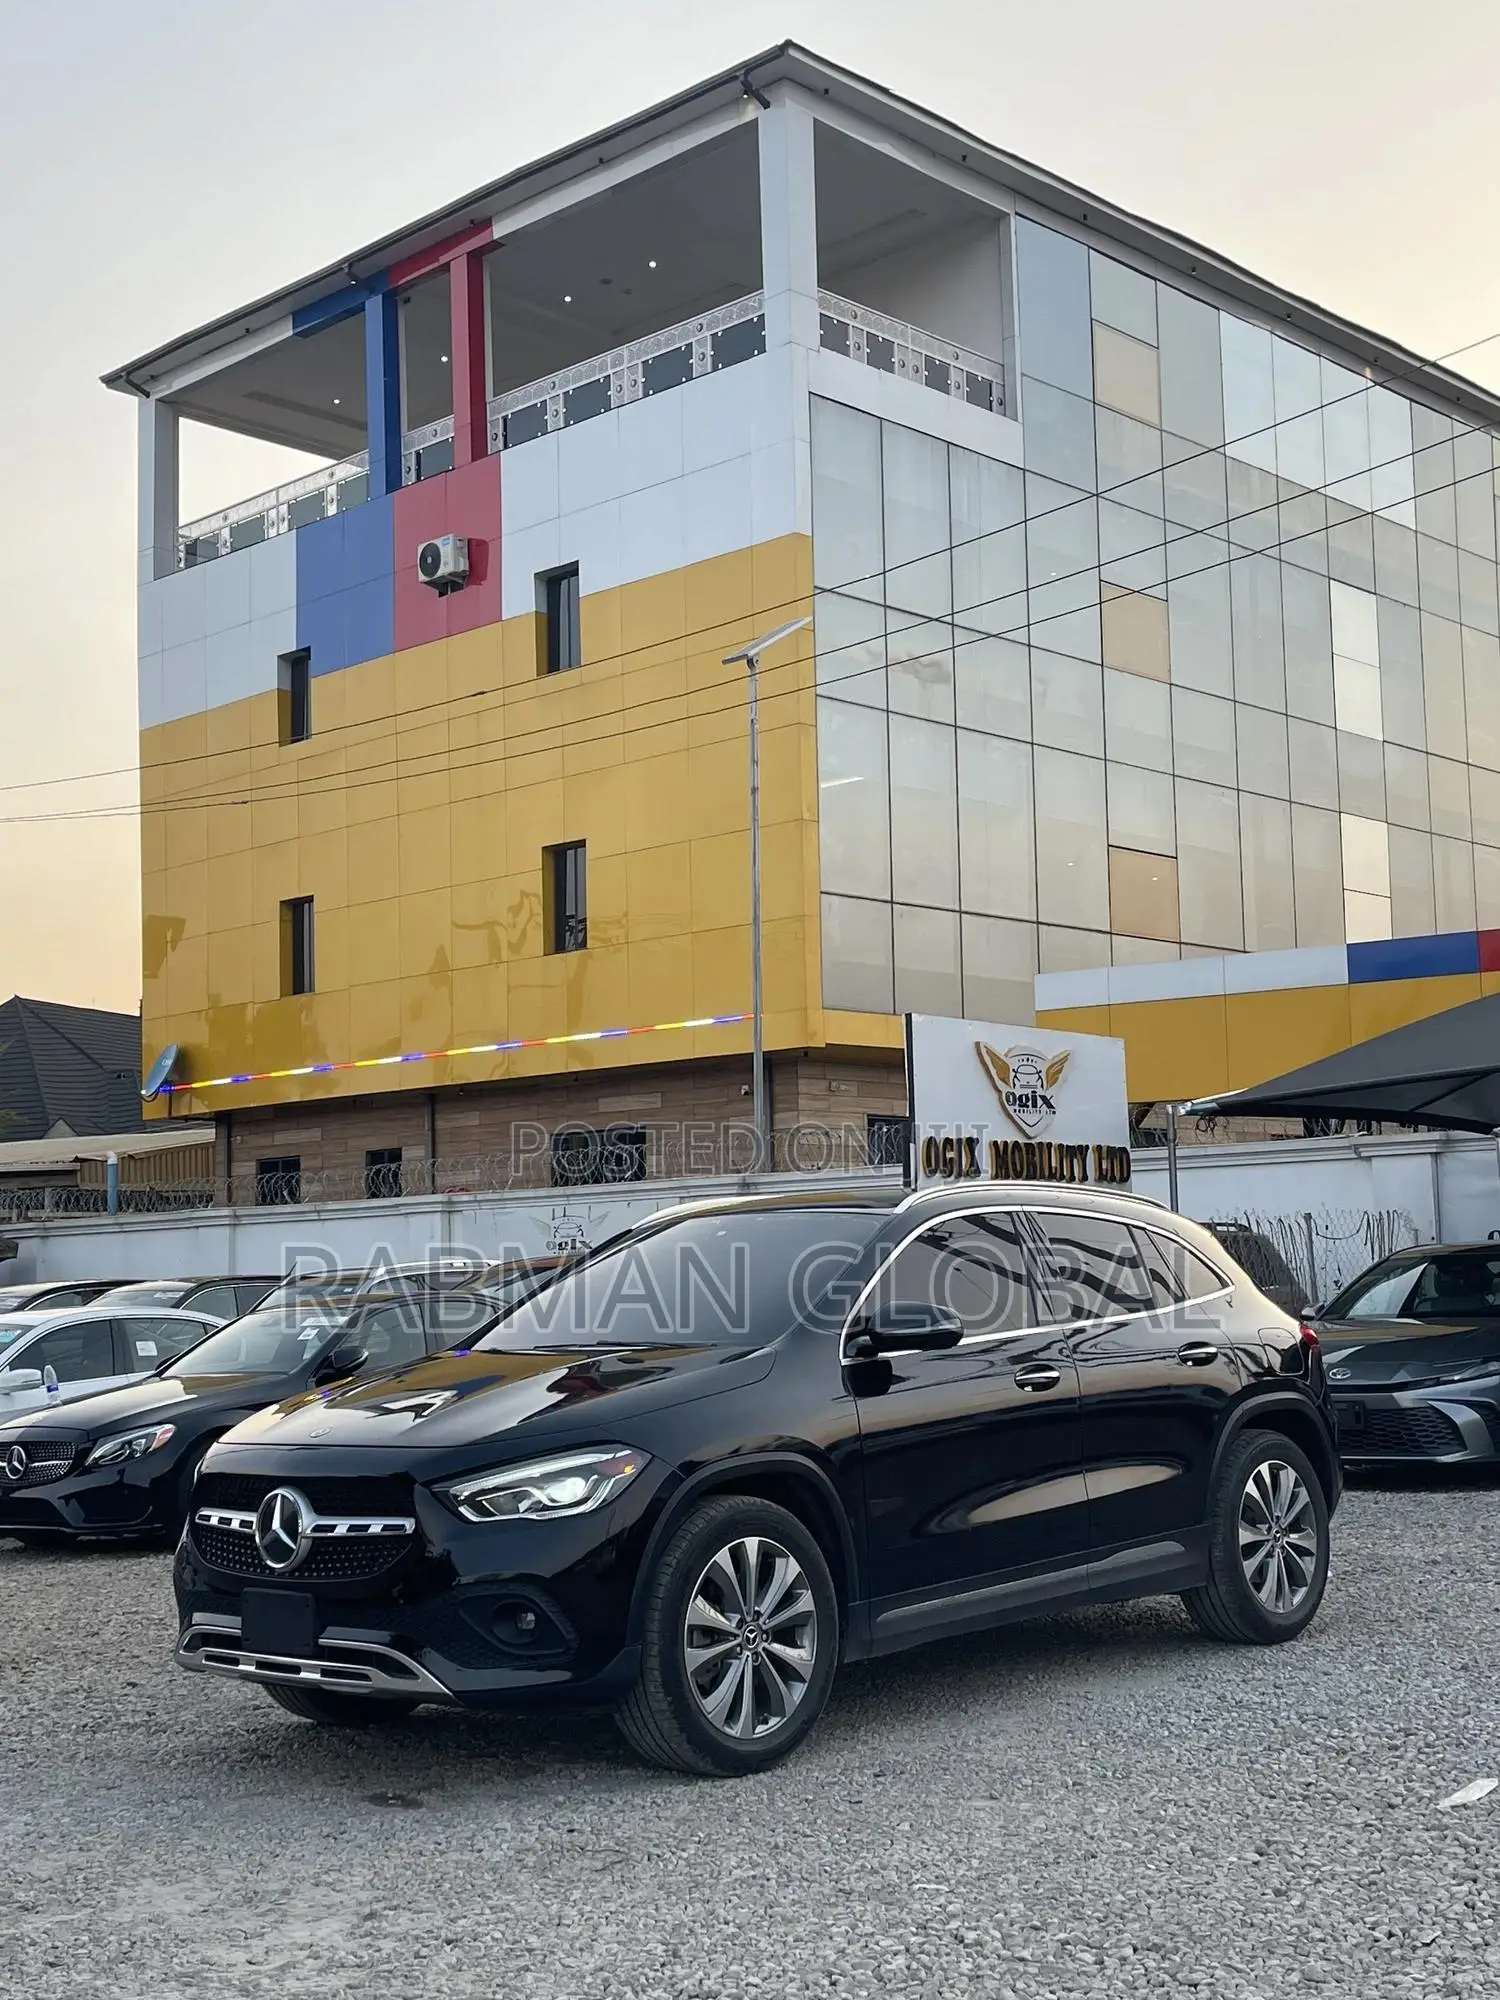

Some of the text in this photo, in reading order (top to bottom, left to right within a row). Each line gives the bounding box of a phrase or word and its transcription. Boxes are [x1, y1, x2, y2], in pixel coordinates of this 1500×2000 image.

[921, 1135, 1131, 1184] OGIX MOBILITY LTD
